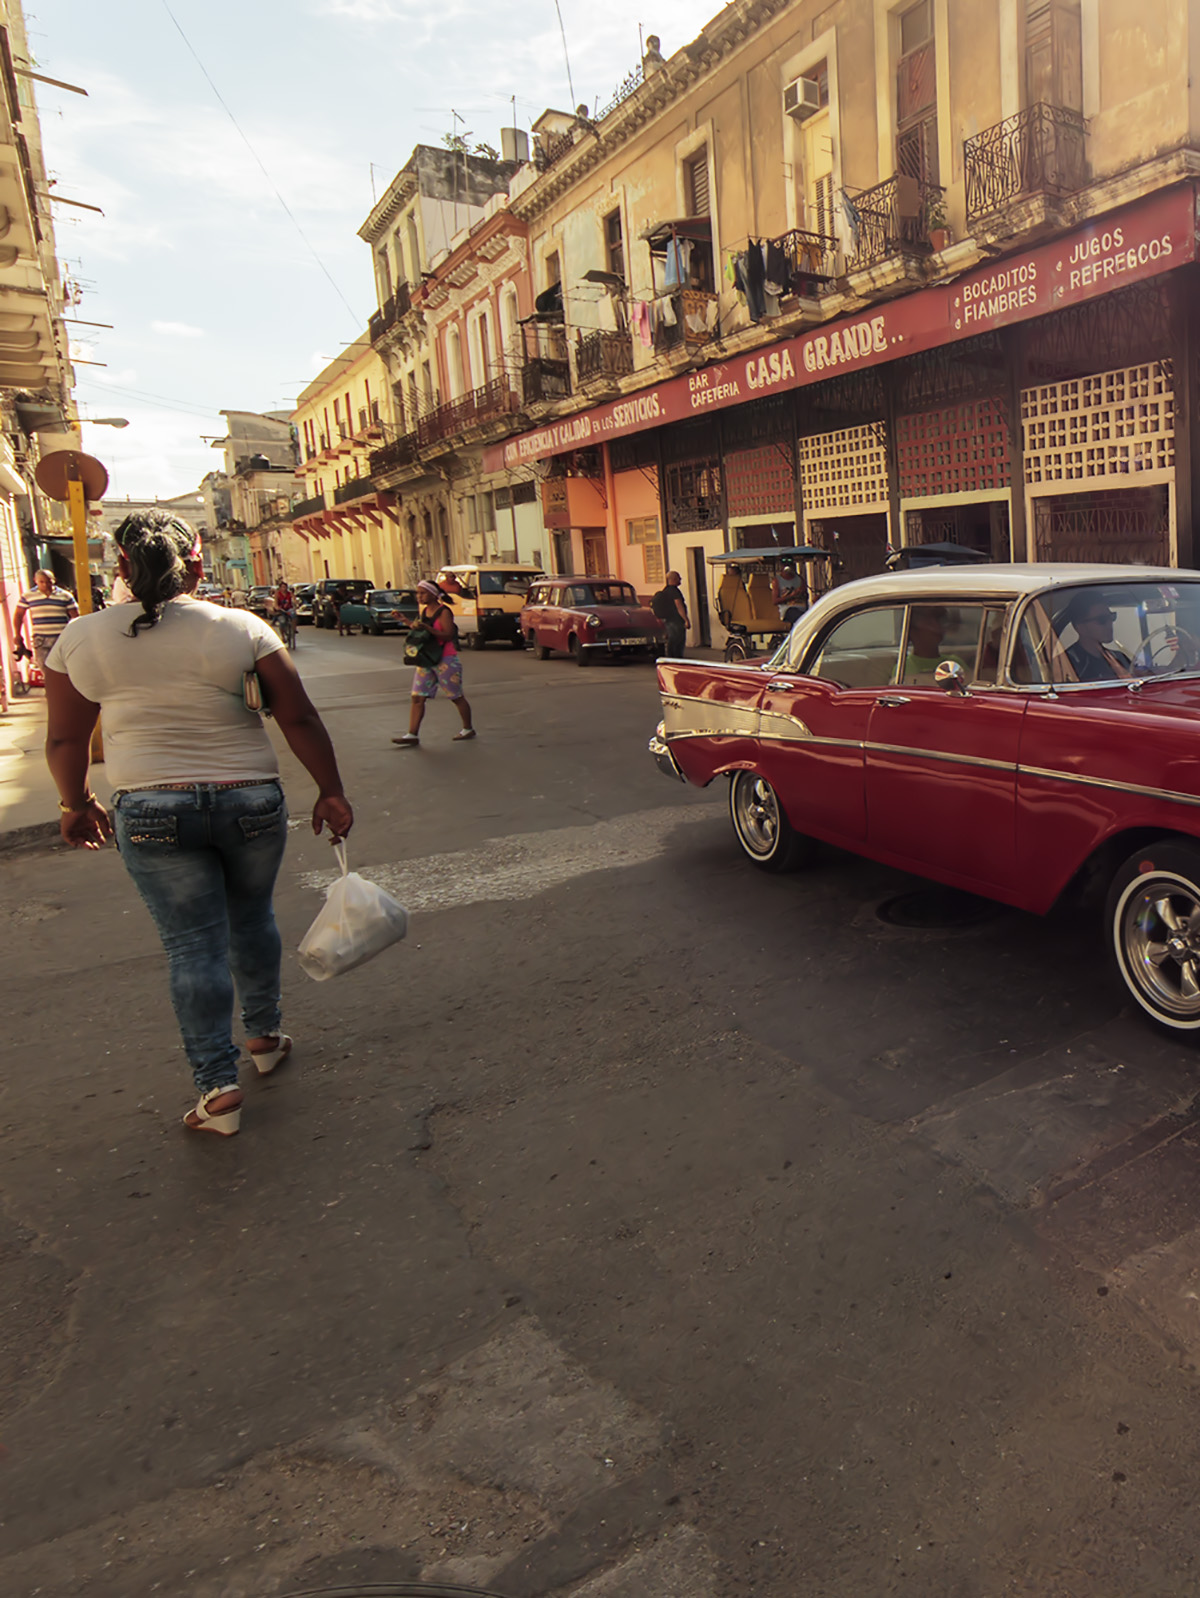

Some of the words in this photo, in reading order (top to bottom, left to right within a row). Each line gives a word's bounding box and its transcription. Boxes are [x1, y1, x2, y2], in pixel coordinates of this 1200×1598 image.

[1069, 227, 1124, 264] JUGOS
[963, 262, 1037, 303] BOCADITOS
[964, 284, 1037, 324] FIAMBRES
[688, 371, 710, 391] BAR
[745, 348, 796, 390] CASA
[690, 380, 740, 409] CAFETERIA
[552, 426, 559, 447] Y
[560, 415, 592, 446] CALIDAD
[592, 419, 601, 433] EN
[601, 415, 614, 430] LOS
